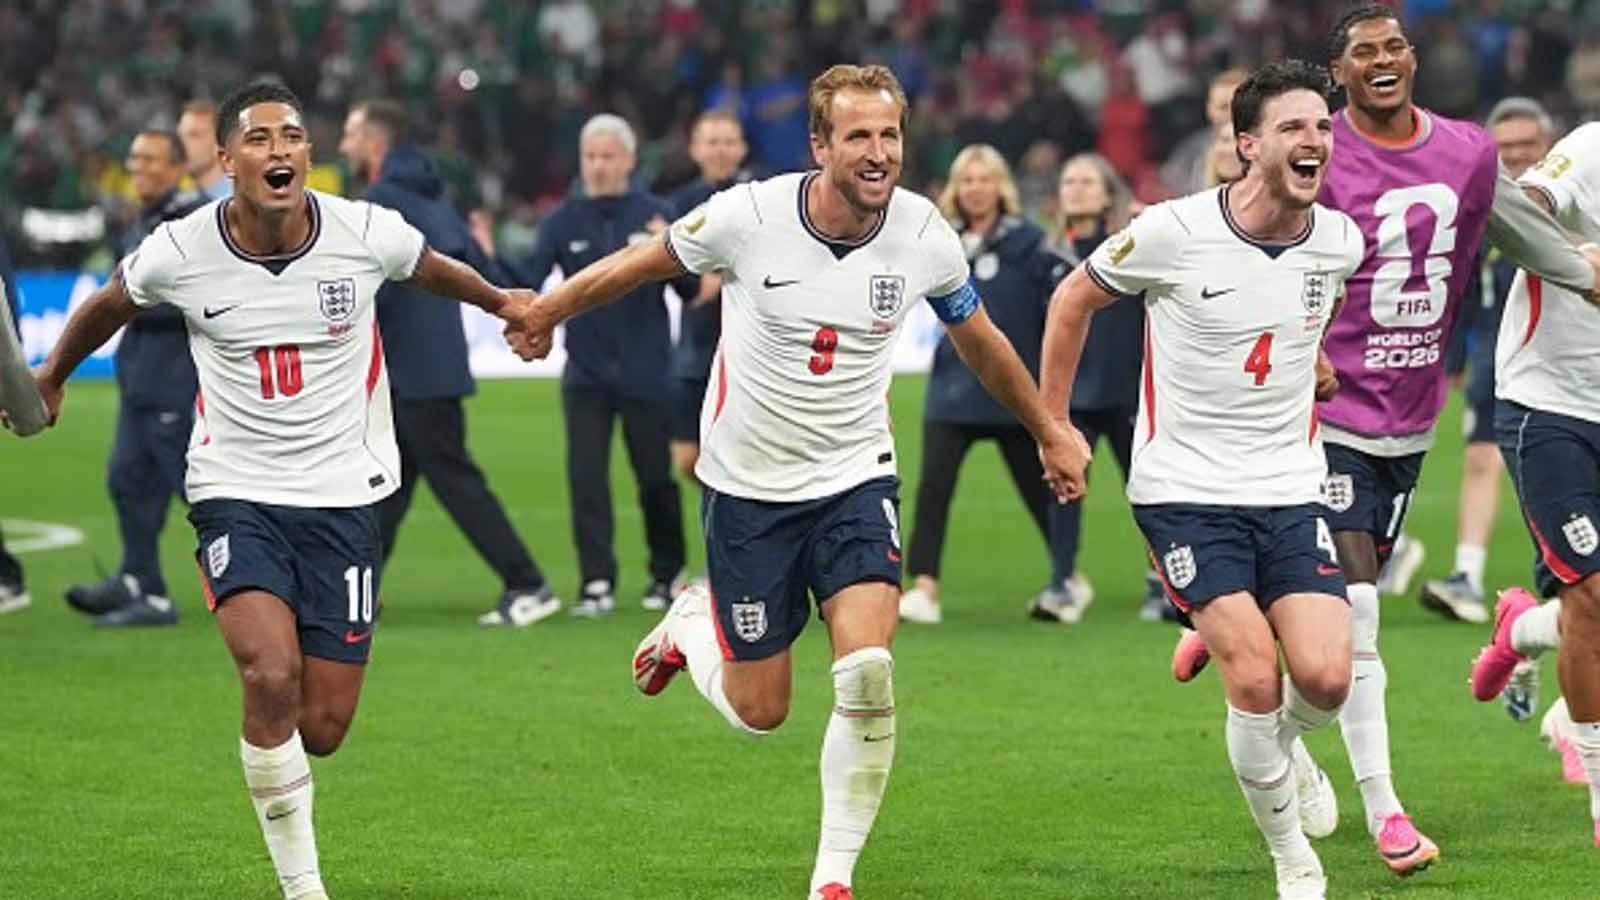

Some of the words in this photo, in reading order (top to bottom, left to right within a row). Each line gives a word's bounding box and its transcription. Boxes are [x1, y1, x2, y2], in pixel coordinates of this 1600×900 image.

[1397, 299, 1431, 315] FIFA
[808, 327, 838, 375] 9
[1244, 331, 1274, 386] 4
[1365, 344, 1439, 368] 2026
[1367, 332, 1423, 346] WORLD
[252, 345, 304, 399] 10
[1316, 517, 1337, 562] 4
[344, 566, 373, 623] 10
